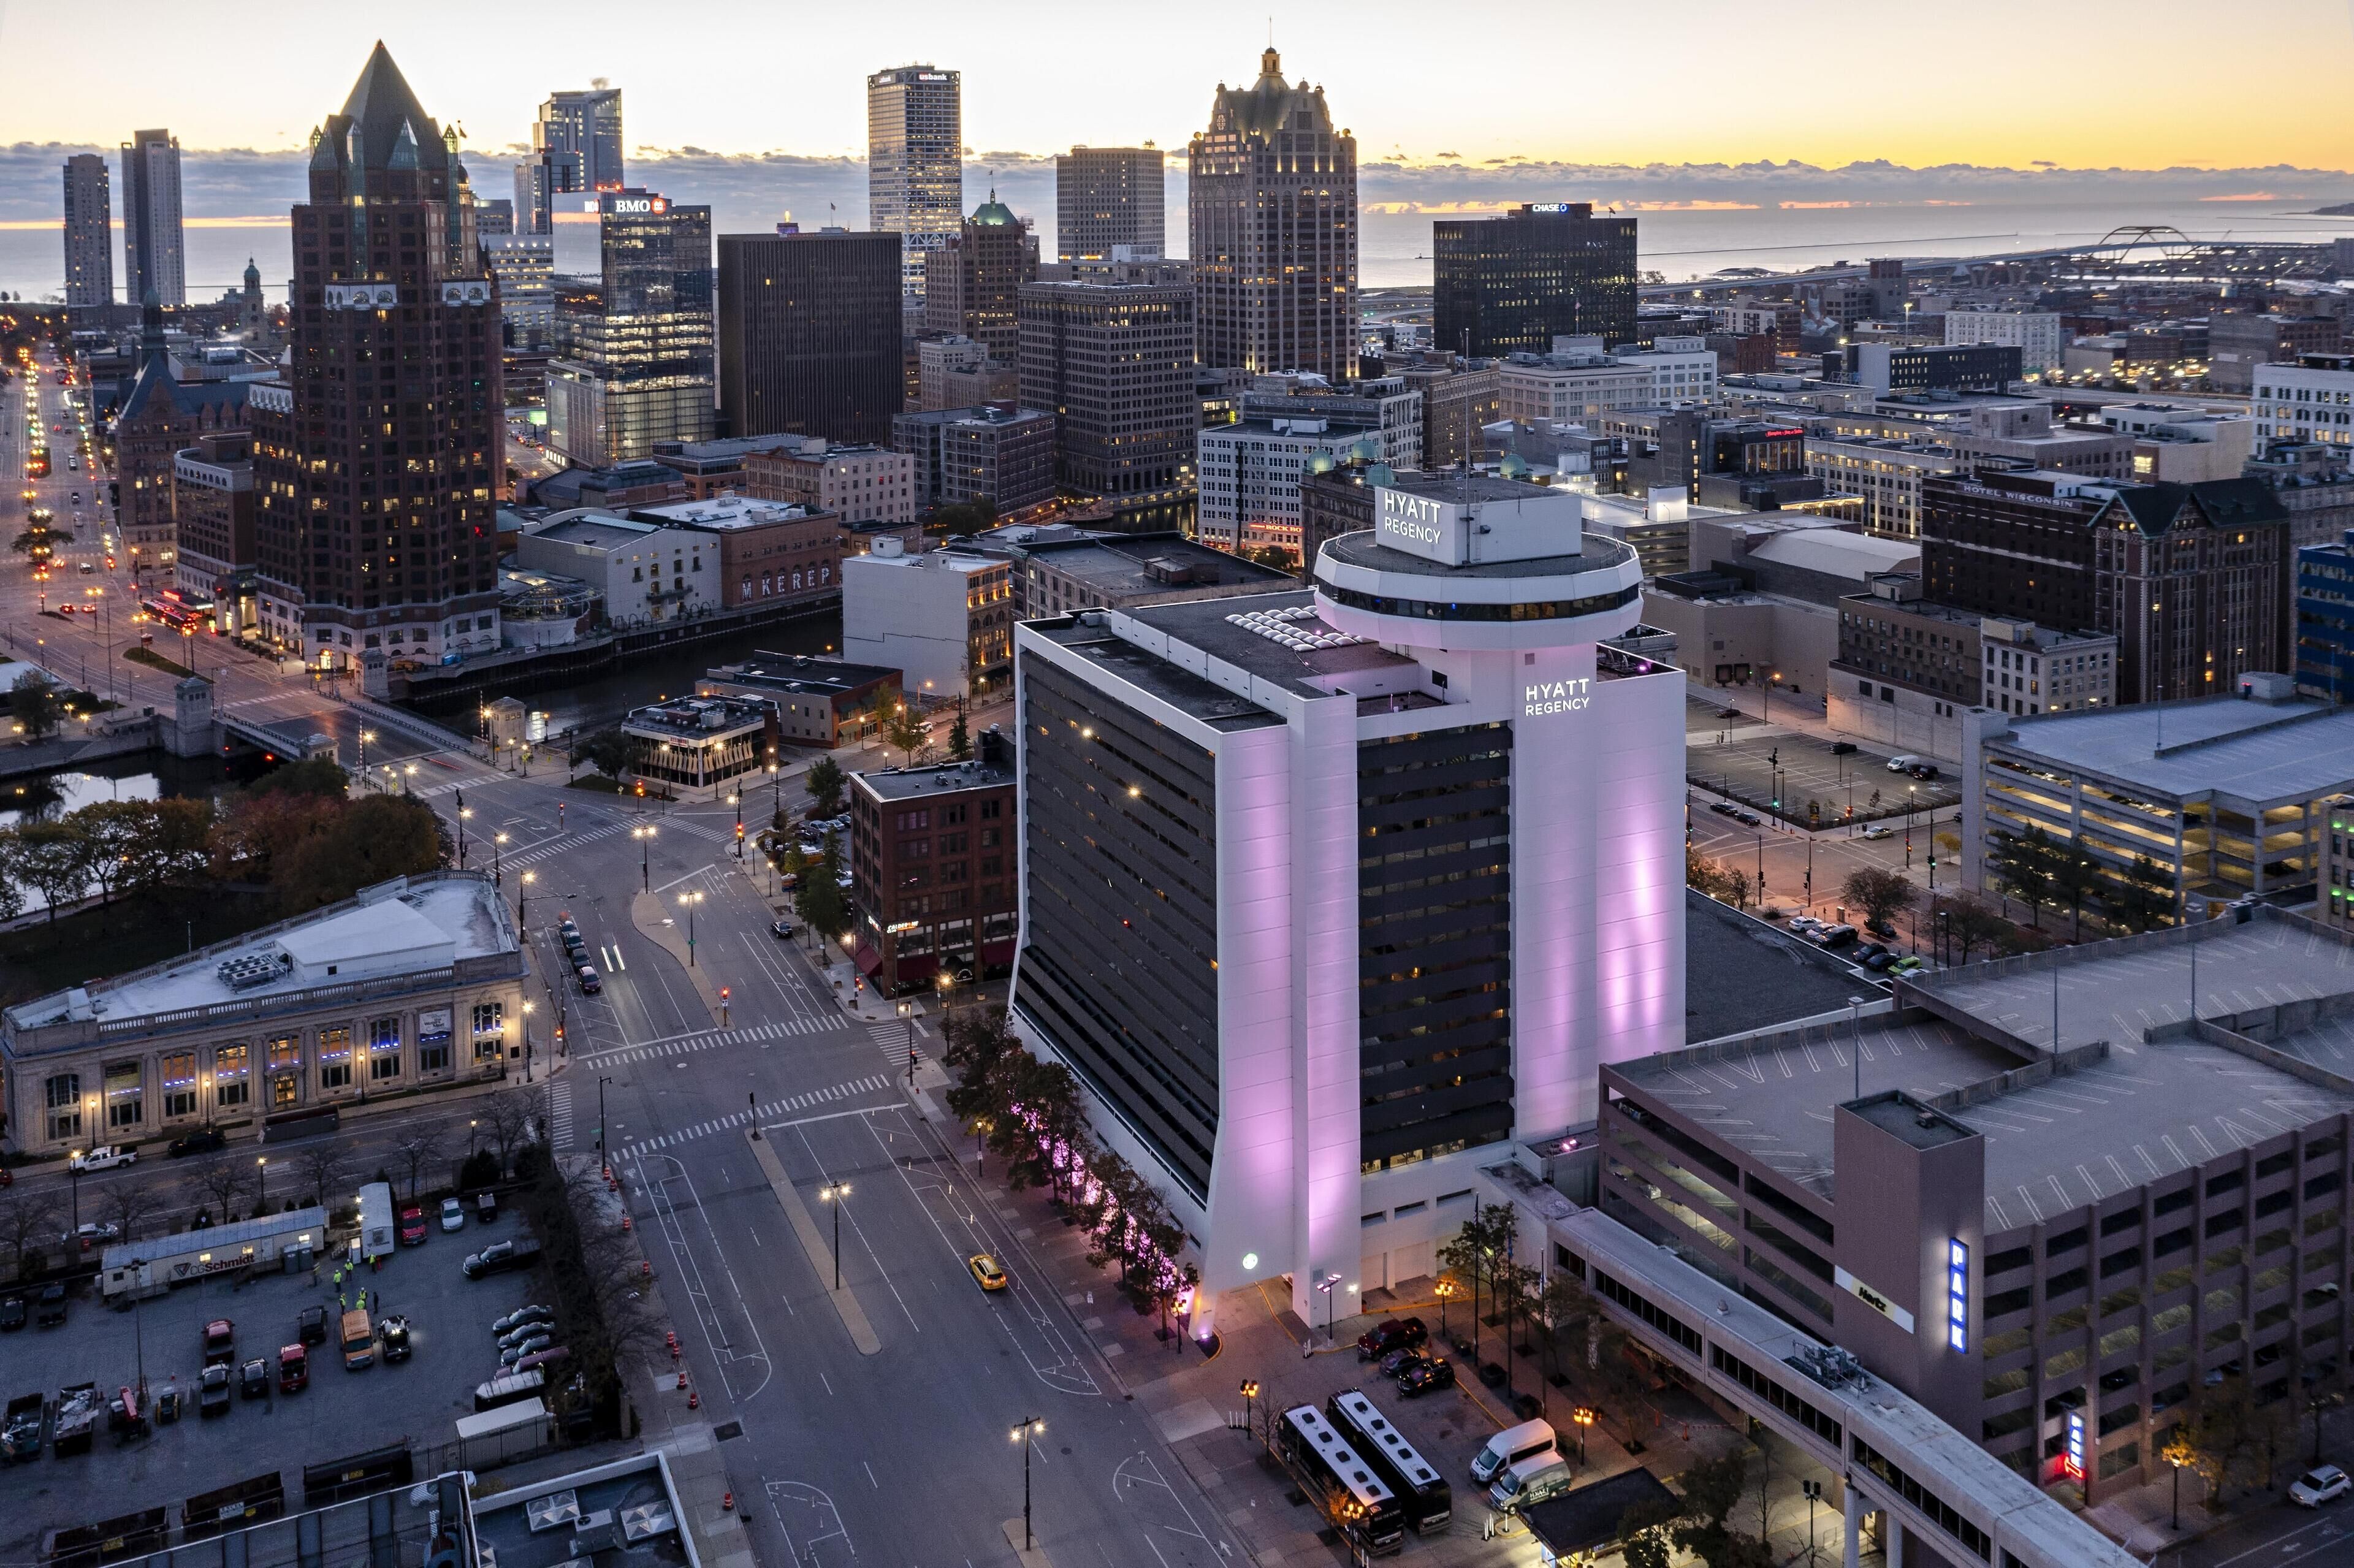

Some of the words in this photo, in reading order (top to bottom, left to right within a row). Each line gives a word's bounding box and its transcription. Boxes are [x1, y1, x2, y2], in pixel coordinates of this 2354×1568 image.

[615, 200, 650, 212] BMO
[1385, 491, 1441, 523] HYATT
[1964, 485, 2002, 497] HOTEL
[2005, 492, 2073, 508] WISCONSIN
[1385, 516, 1442, 544] REGENCY
[1526, 678, 1590, 701] HYATT
[1525, 697, 1590, 716] REGENCY
[1859, 1287, 1886, 1312] Hertz
[1952, 1244, 1964, 1349] PARK
